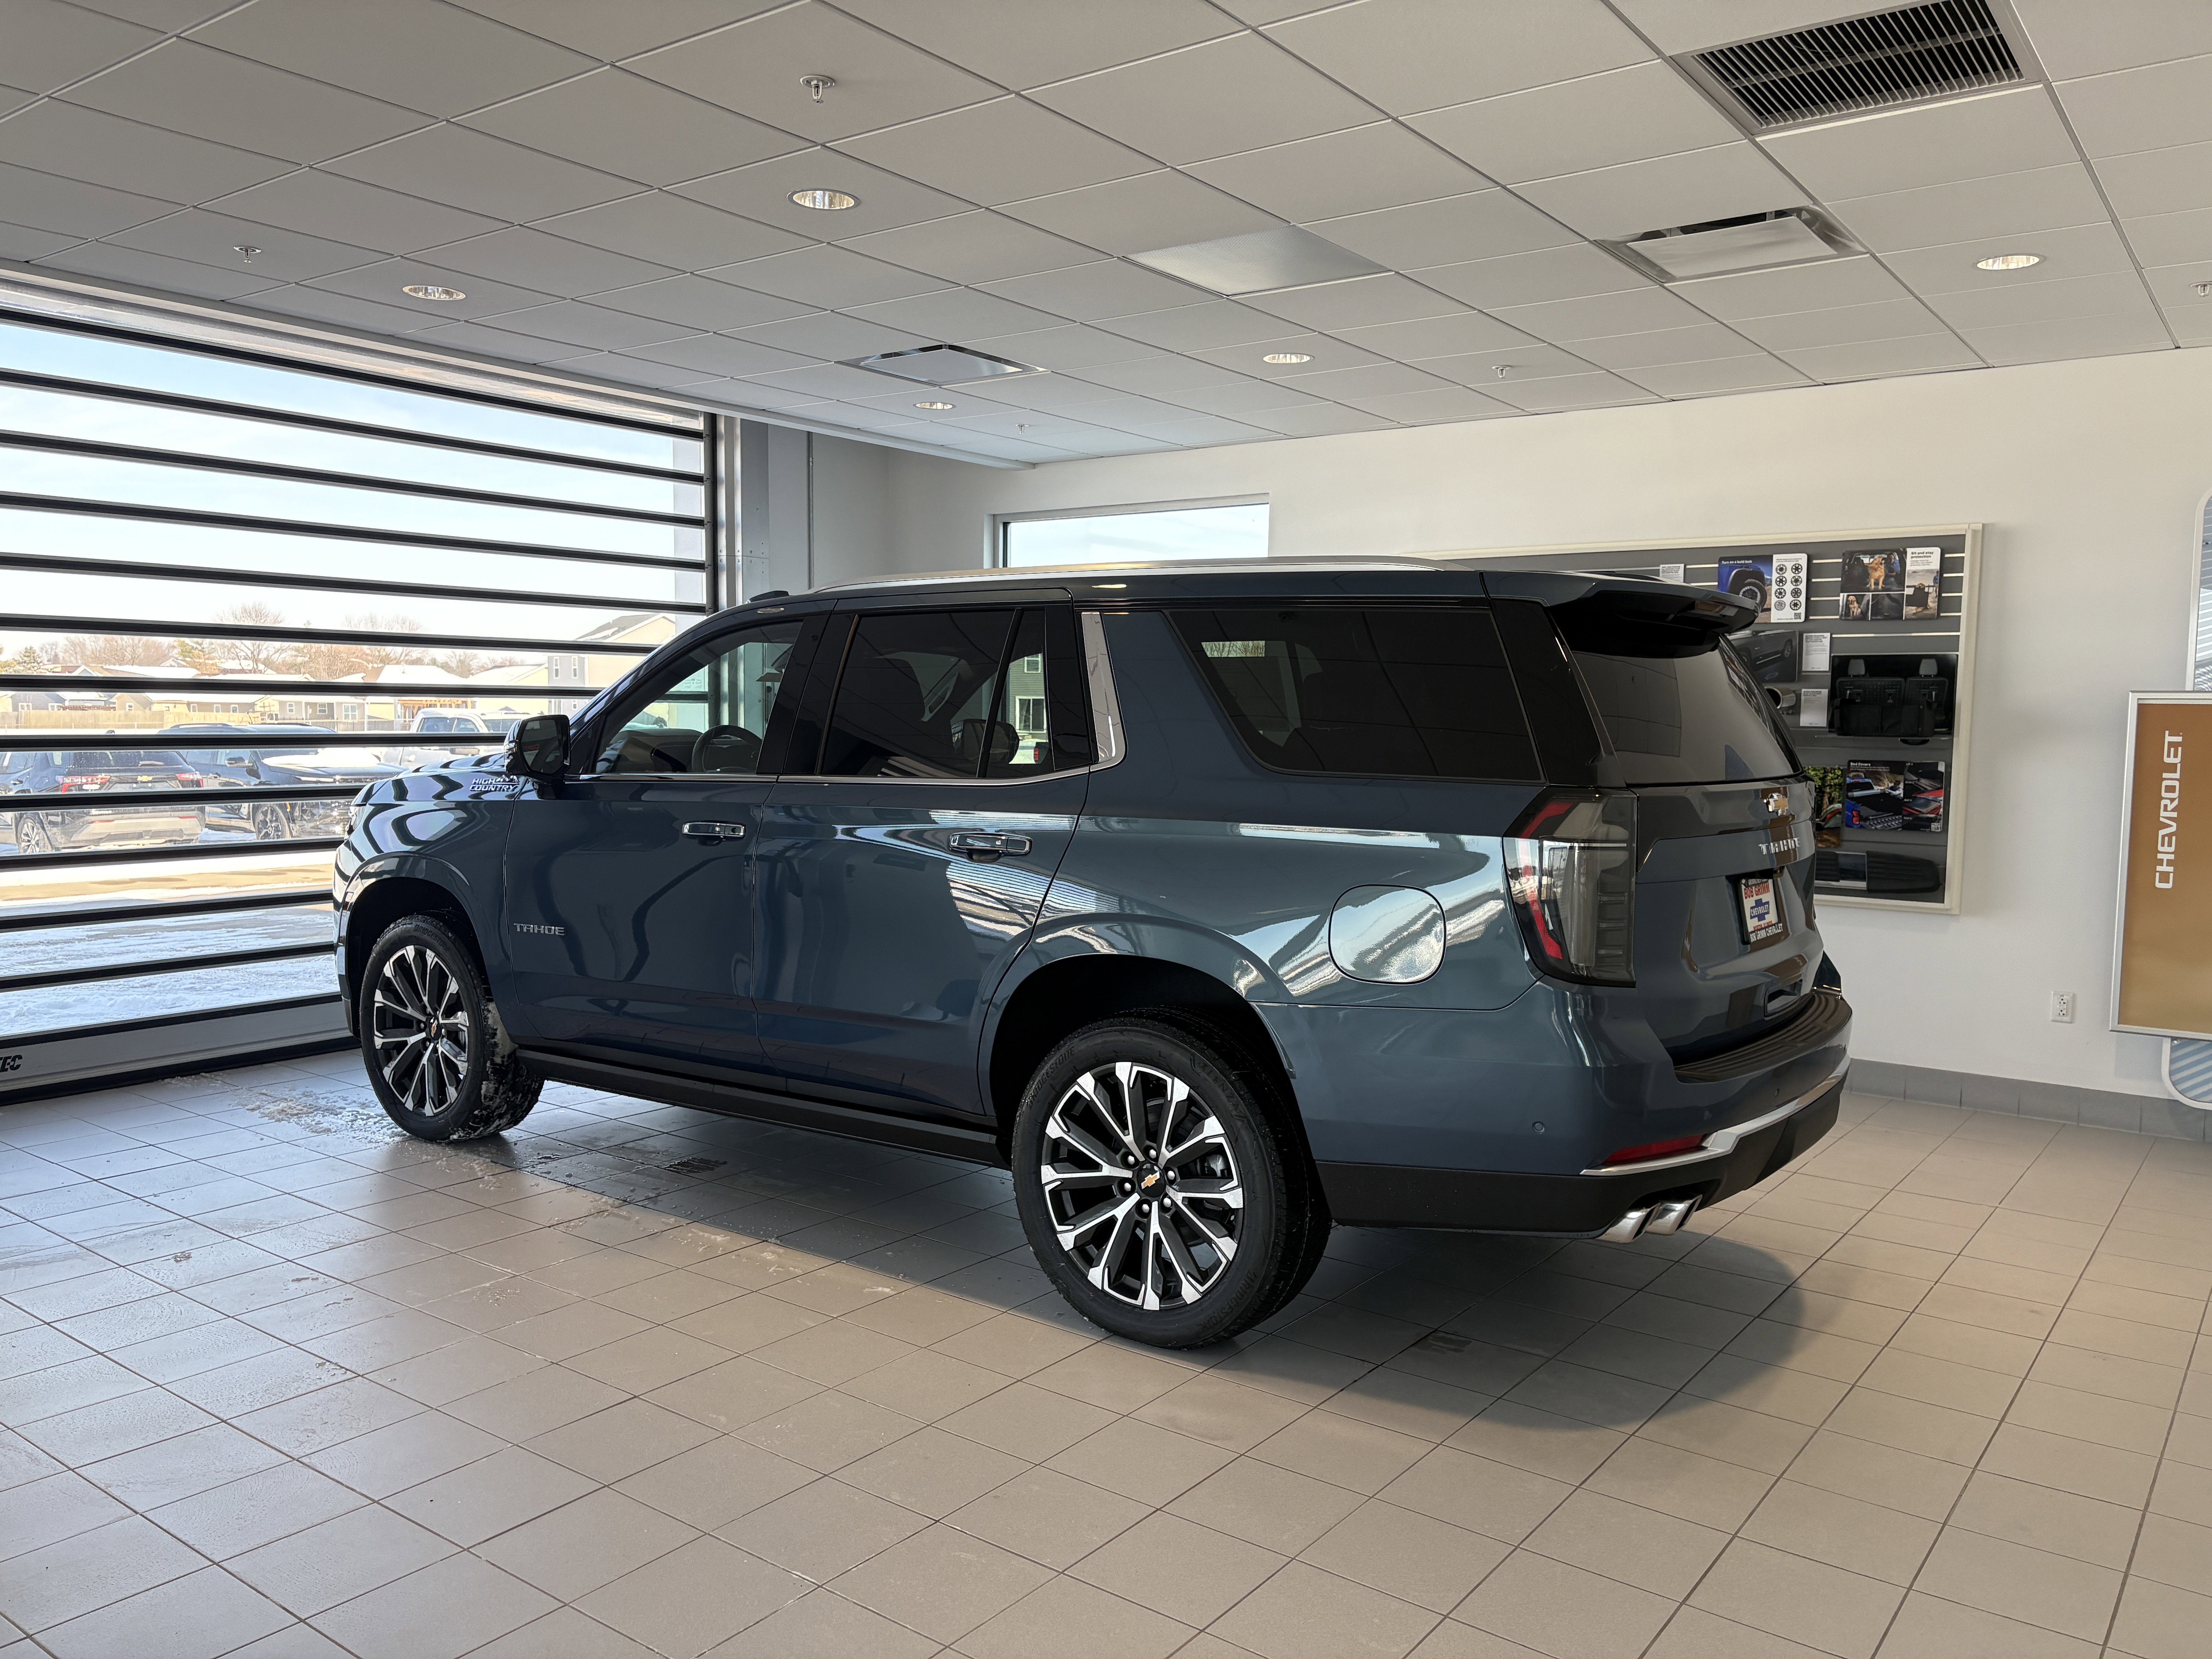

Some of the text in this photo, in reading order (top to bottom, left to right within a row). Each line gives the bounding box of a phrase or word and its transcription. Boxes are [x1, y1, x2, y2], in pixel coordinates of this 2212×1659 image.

[2155, 730, 2183, 889] CHEVROLET
[1758, 838, 1800, 855] TAHOE
[1744, 882, 1770, 900] BOB GRIMM
[1751, 904, 1769, 917] CHEVROLET
[514, 923, 566, 936] TAHOE
